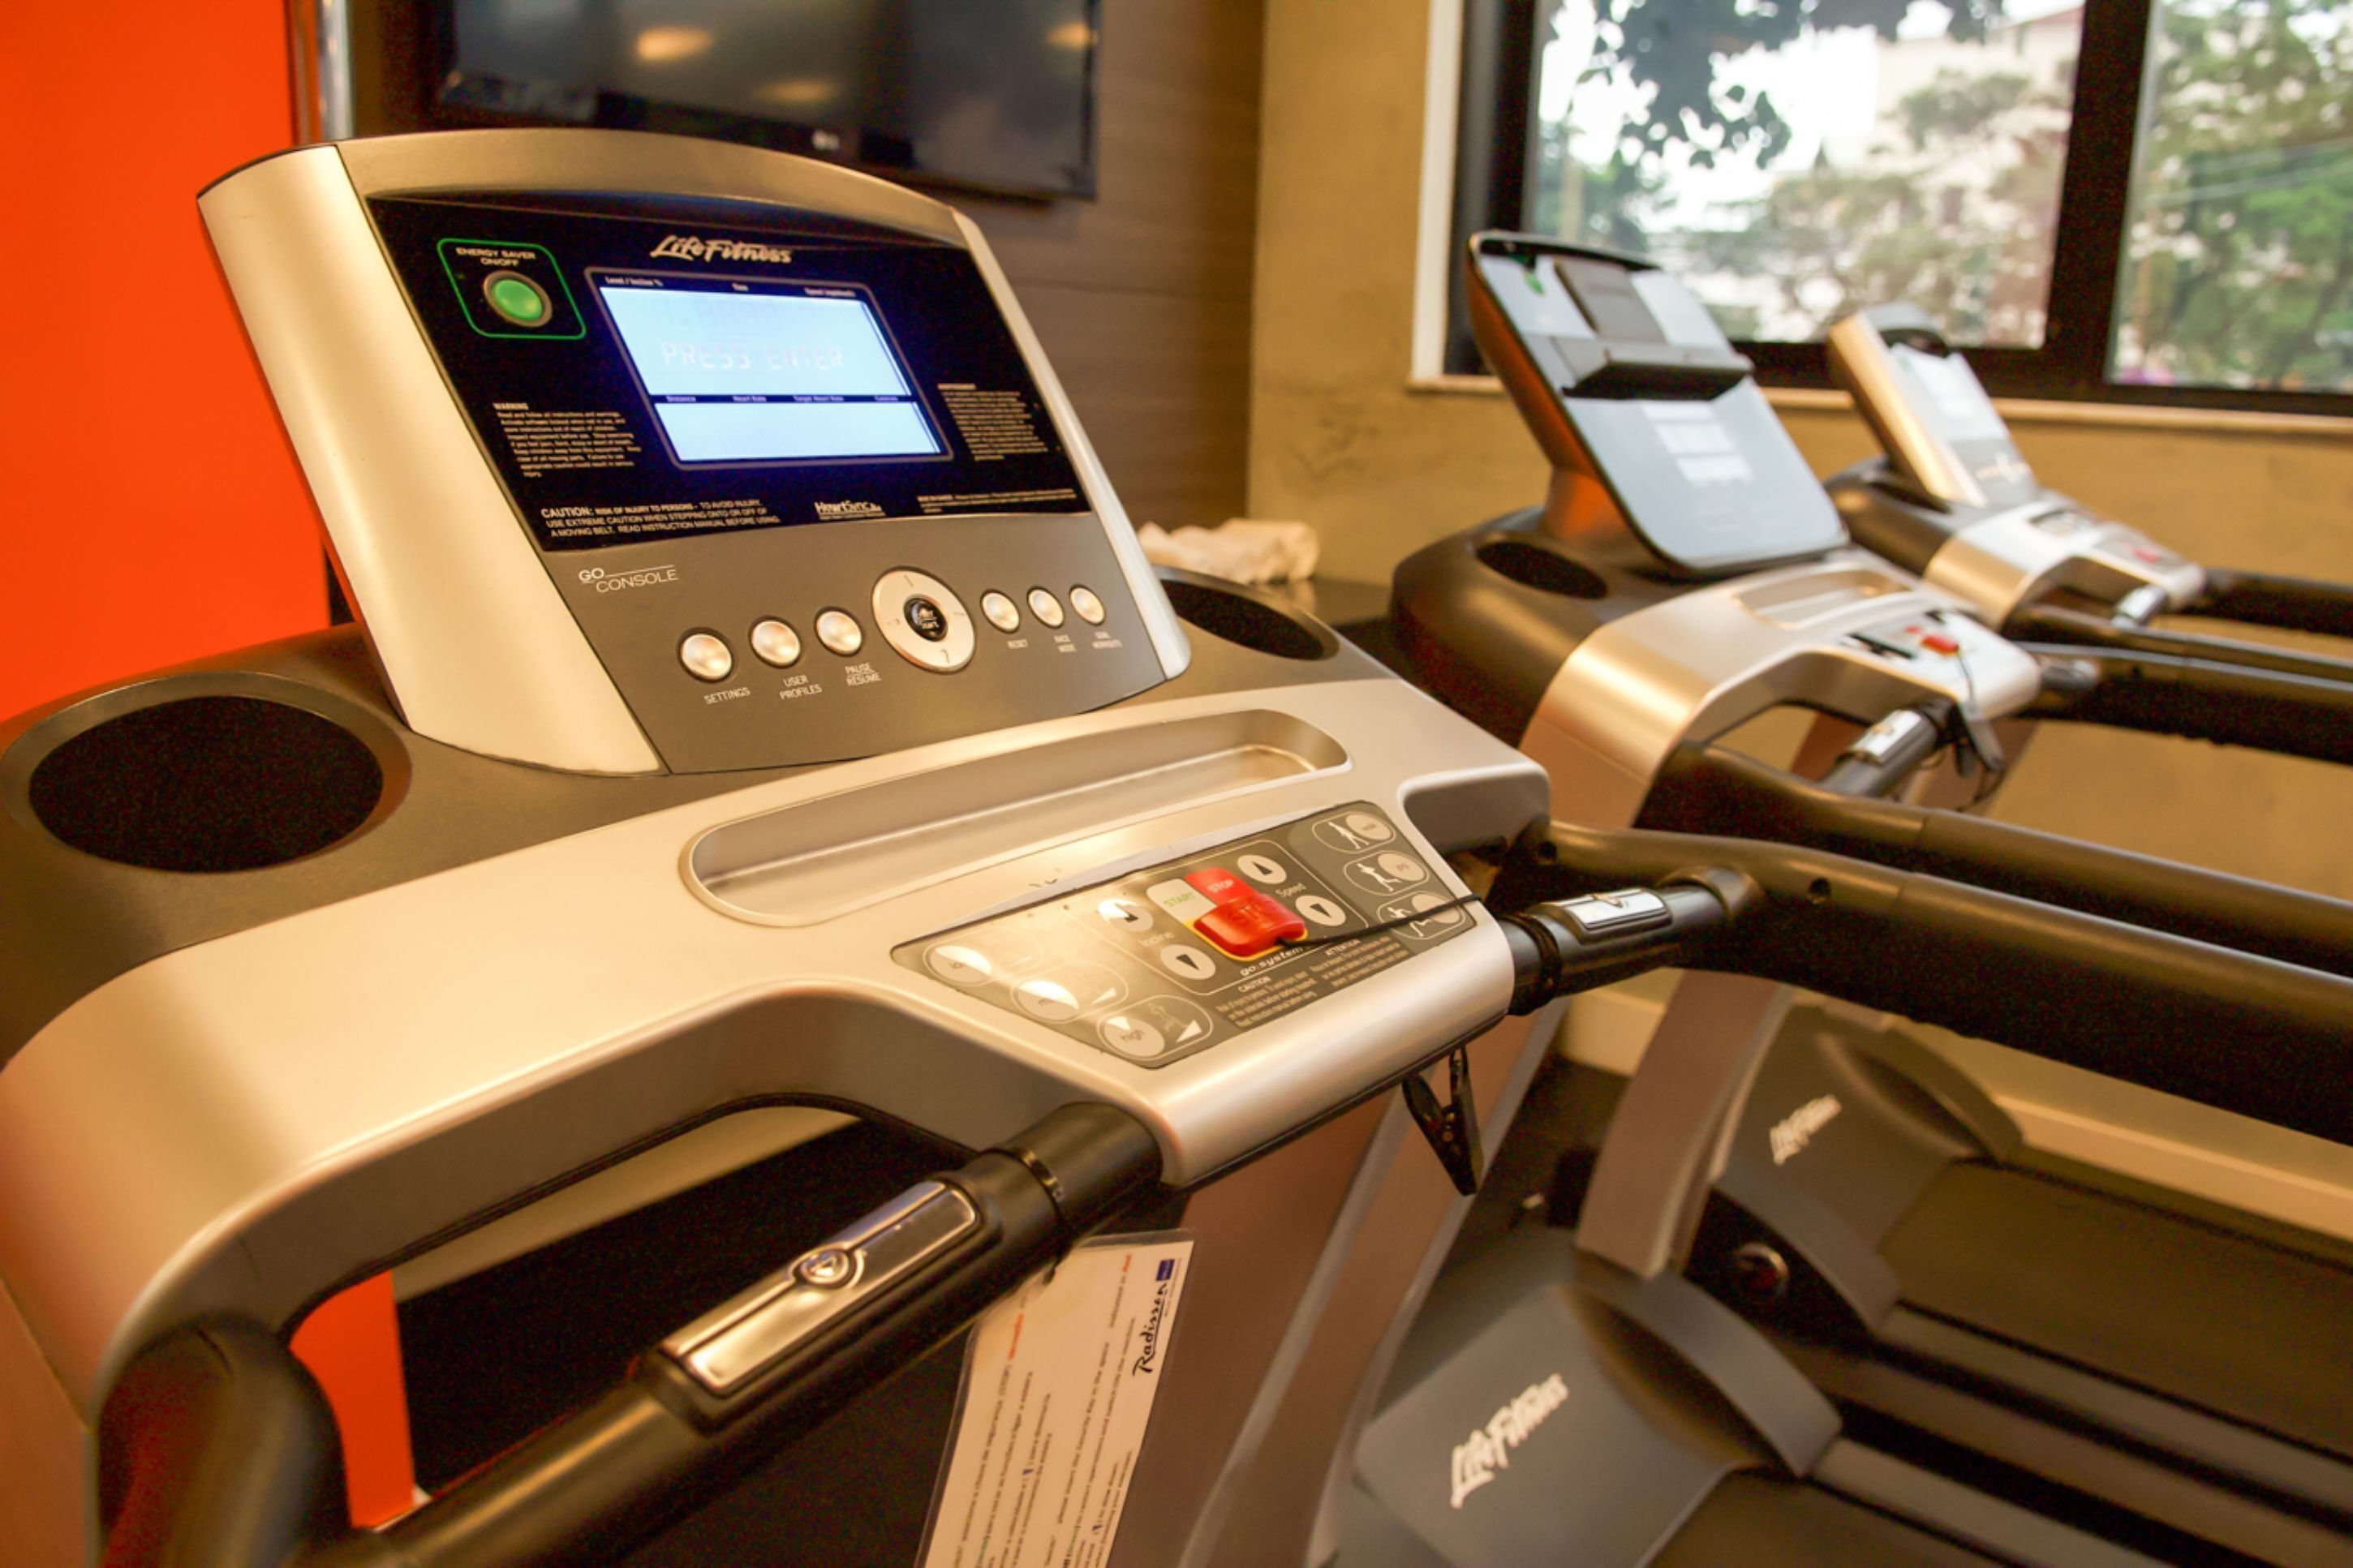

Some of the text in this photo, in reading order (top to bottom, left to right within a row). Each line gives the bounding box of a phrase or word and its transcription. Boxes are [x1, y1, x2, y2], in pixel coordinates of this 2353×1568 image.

[661, 341, 751, 369] PRESS
[540, 506, 594, 518] CAUTION:
[606, 515, 643, 525] CAUTION
[578, 568, 604, 582] GO
[596, 569, 679, 593] CONSOLE
[782, 674, 809, 687] USER
[703, 687, 751, 704] SETTINGS
[779, 684, 823, 700] PROFILES
[1207, 879, 1235, 893] STOP
[1275, 882, 1307, 898] Speed
[1164, 891, 1195, 909] START
[1237, 976, 1272, 993] CAUTION
[1133, 1282, 1167, 1376] Radisson
